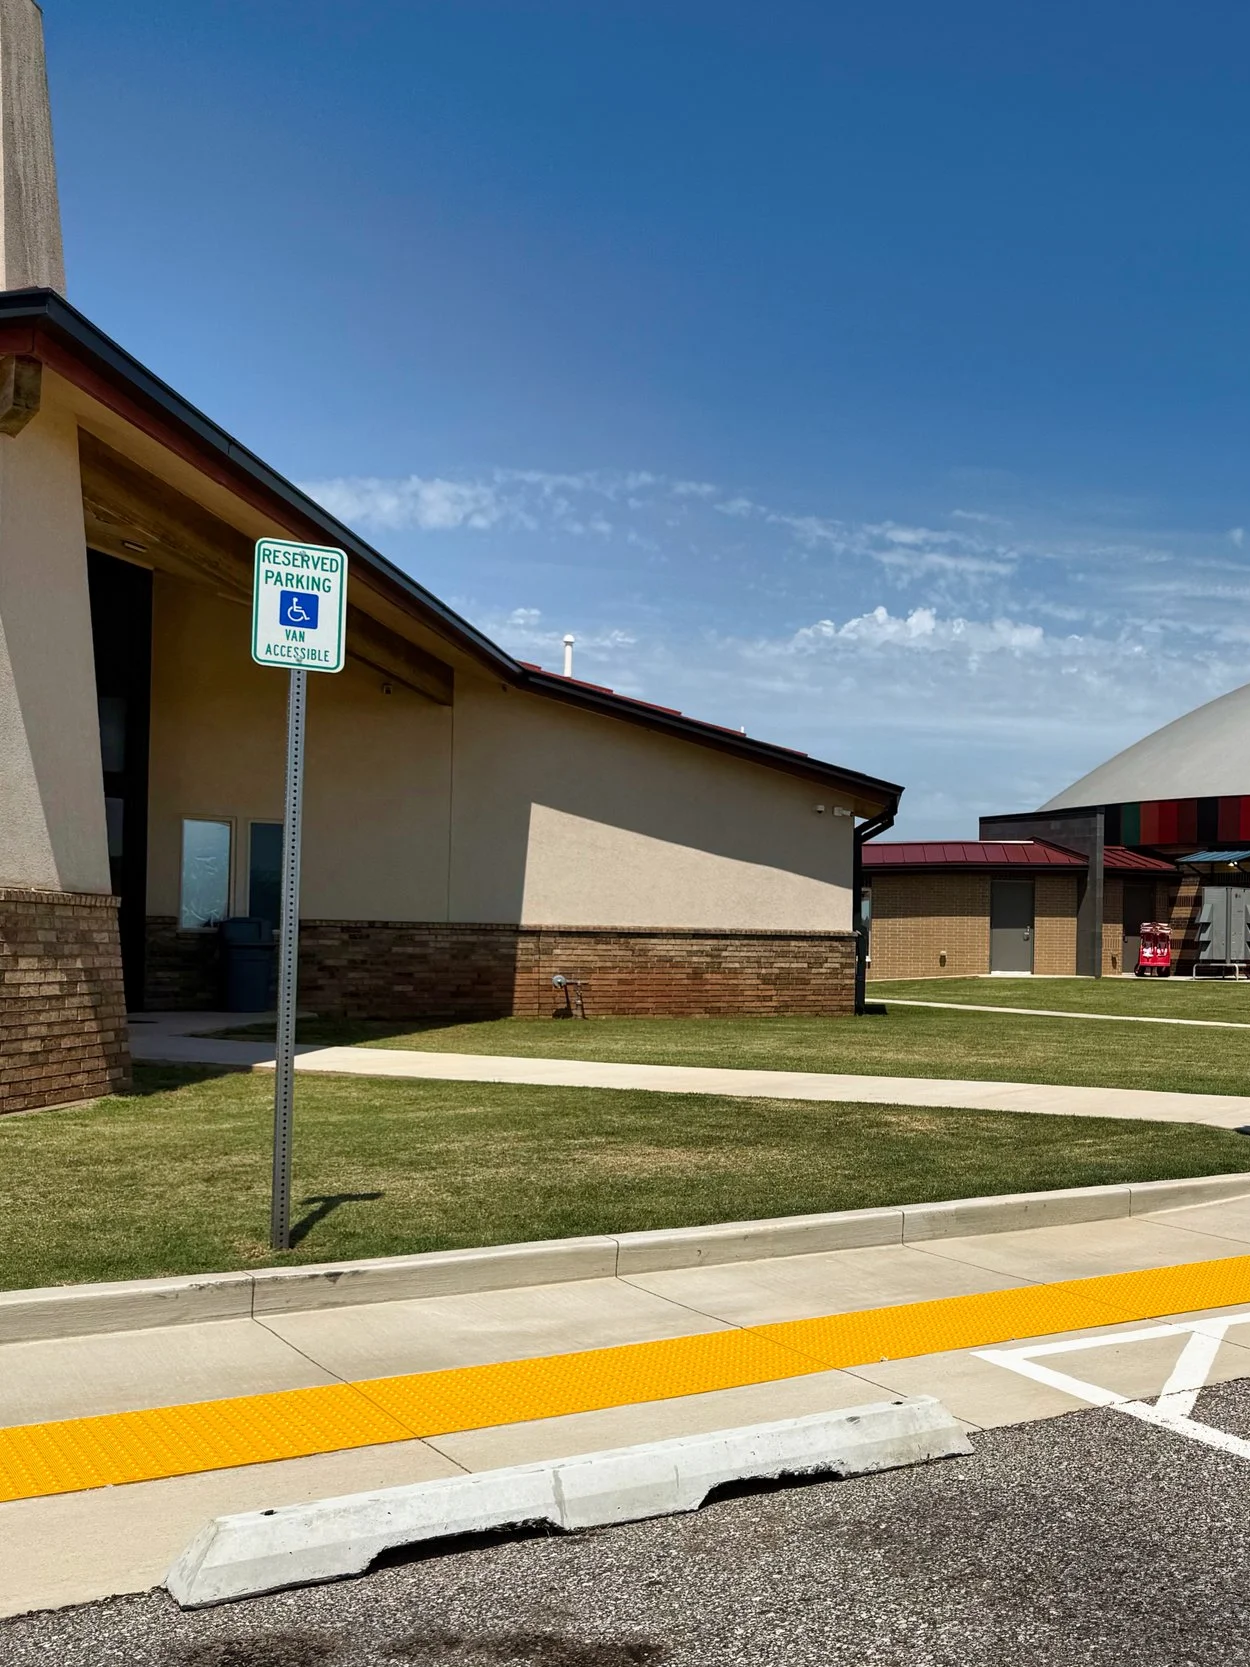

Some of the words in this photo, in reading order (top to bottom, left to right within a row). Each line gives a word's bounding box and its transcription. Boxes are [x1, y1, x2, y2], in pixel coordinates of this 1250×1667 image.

[262, 548, 339, 573] RESERVED
[265, 570, 331, 593] PARKING
[285, 629, 305, 643] VAN
[265, 643, 330, 662] ACCESSIBLE
